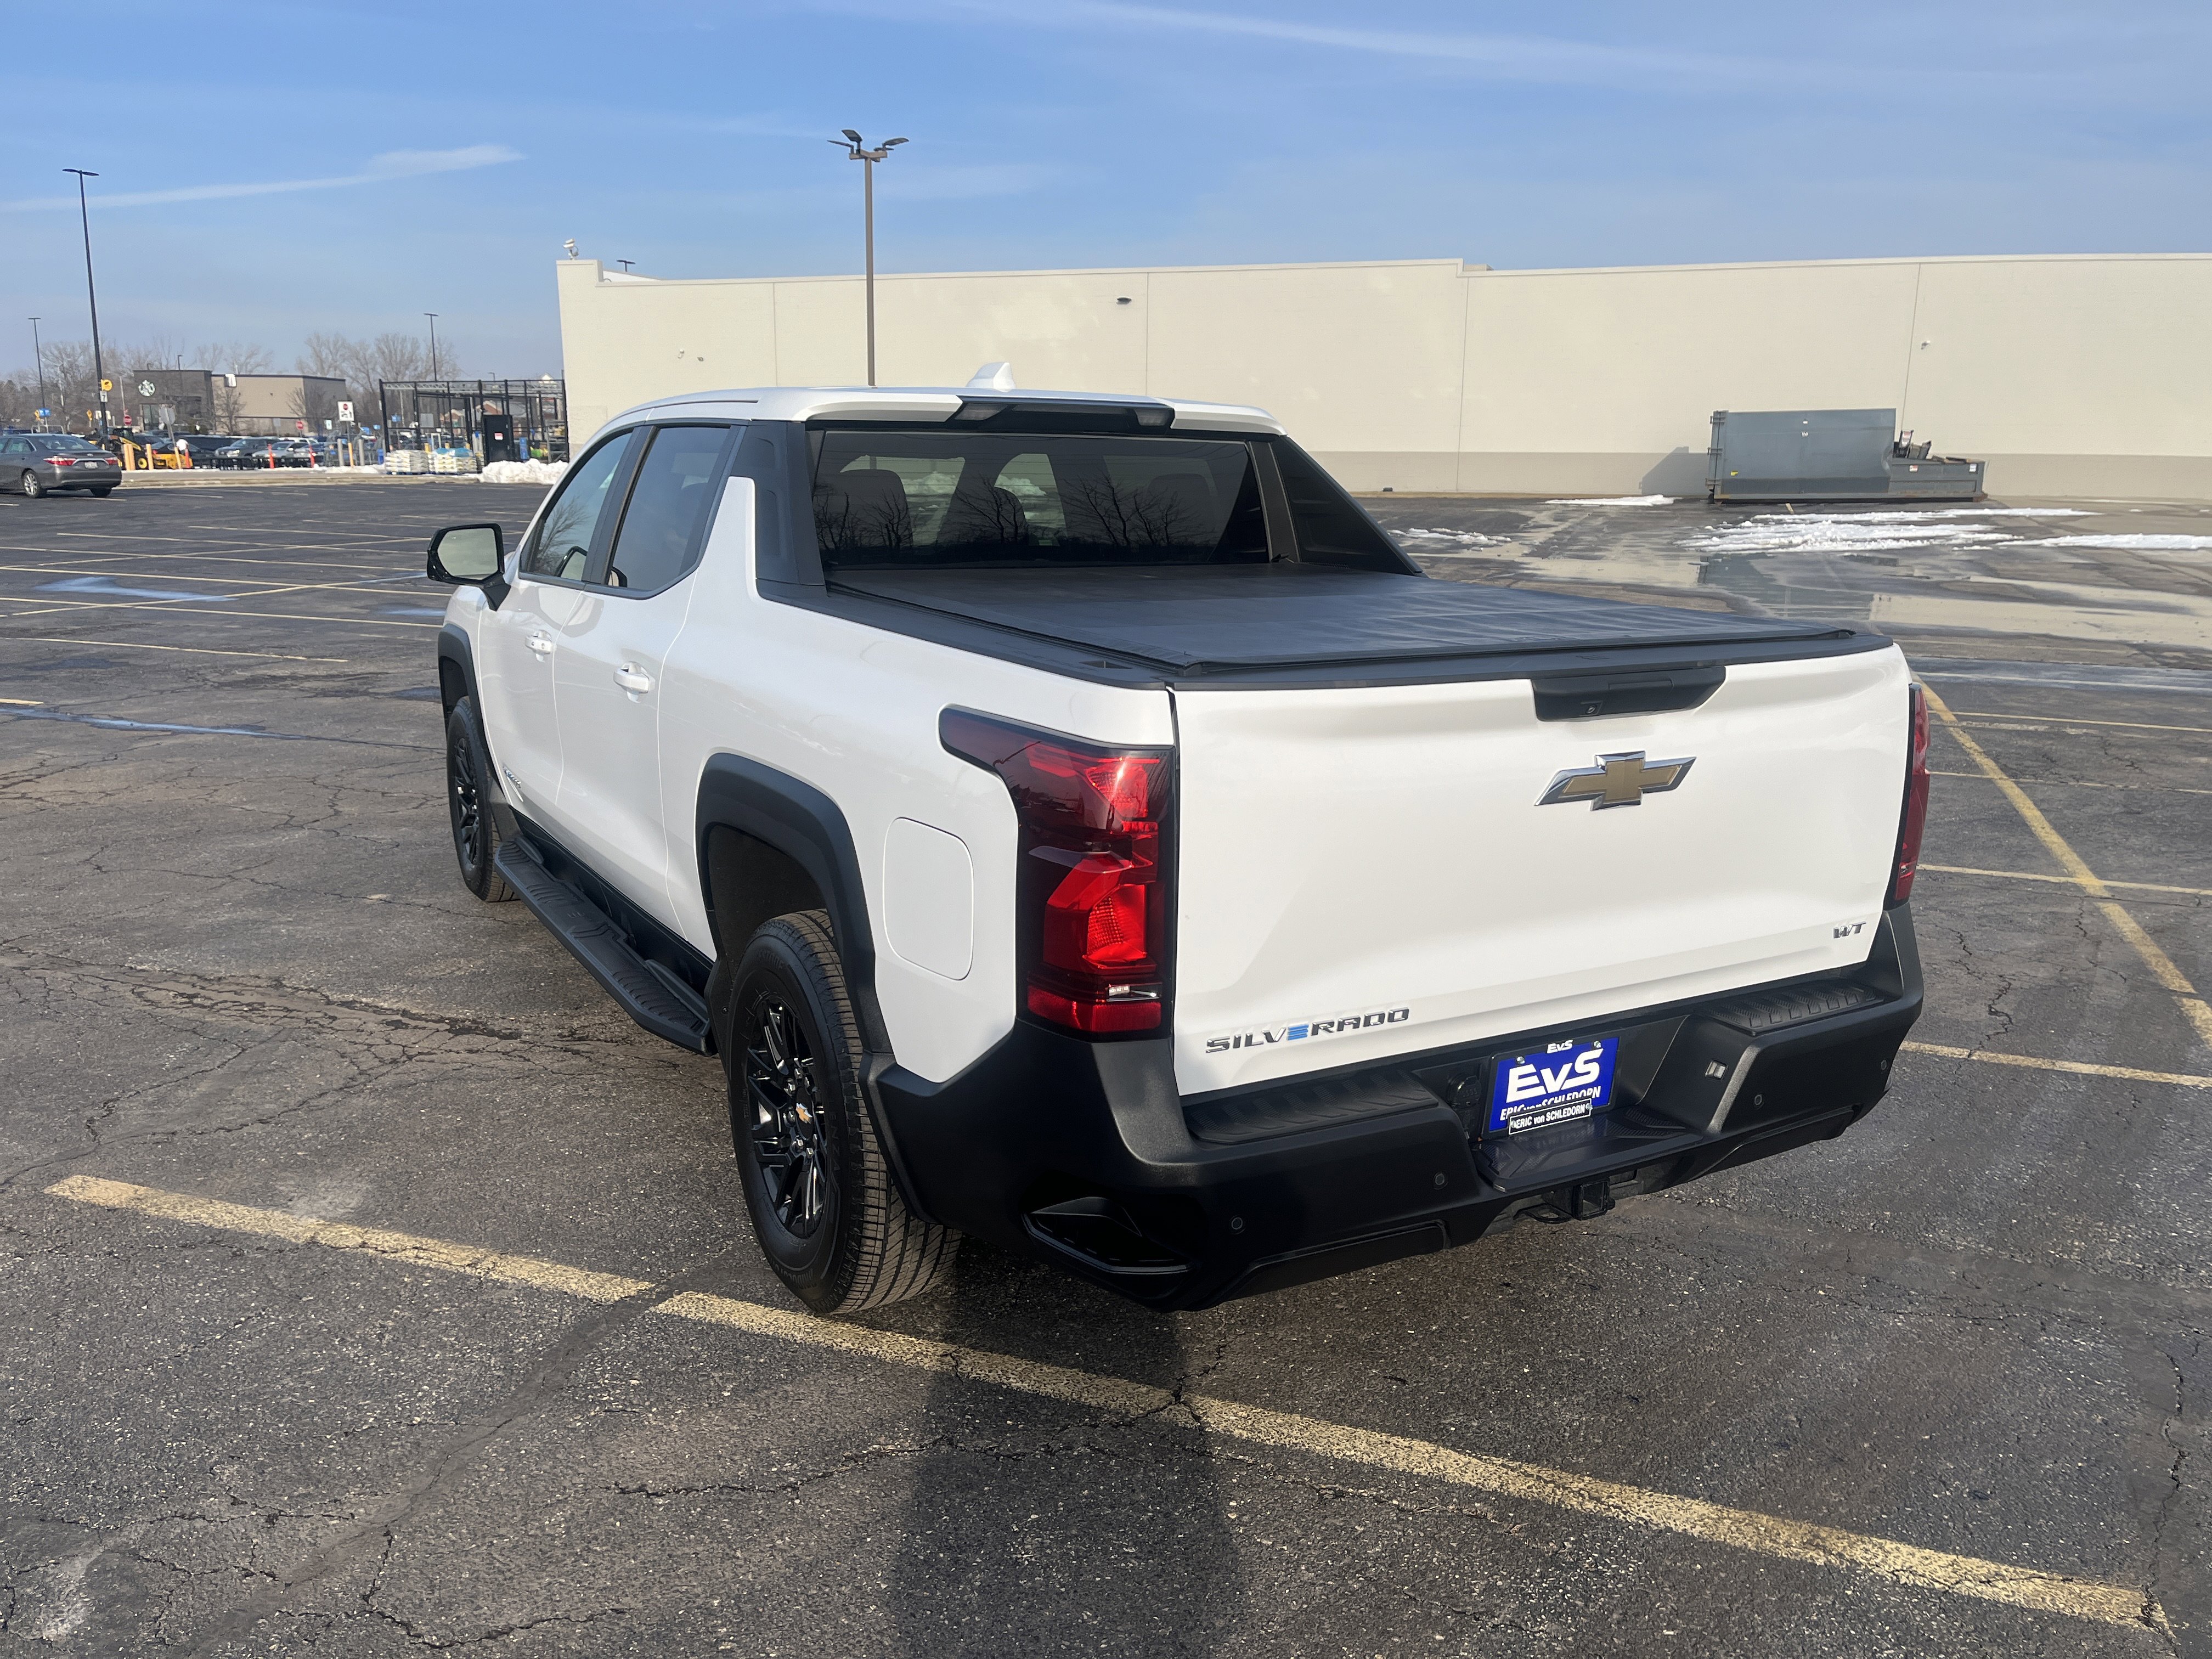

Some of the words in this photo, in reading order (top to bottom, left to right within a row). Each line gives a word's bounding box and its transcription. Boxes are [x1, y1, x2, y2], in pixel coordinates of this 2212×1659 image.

[1833, 921, 1866, 939] WT
[1205, 1007, 1409, 1053] SILVERADO
[1516, 1116, 1533, 1129] ERIC
[1533, 1115, 1545, 1125] von
[1545, 1103, 1585, 1122] SCHLEDORN
